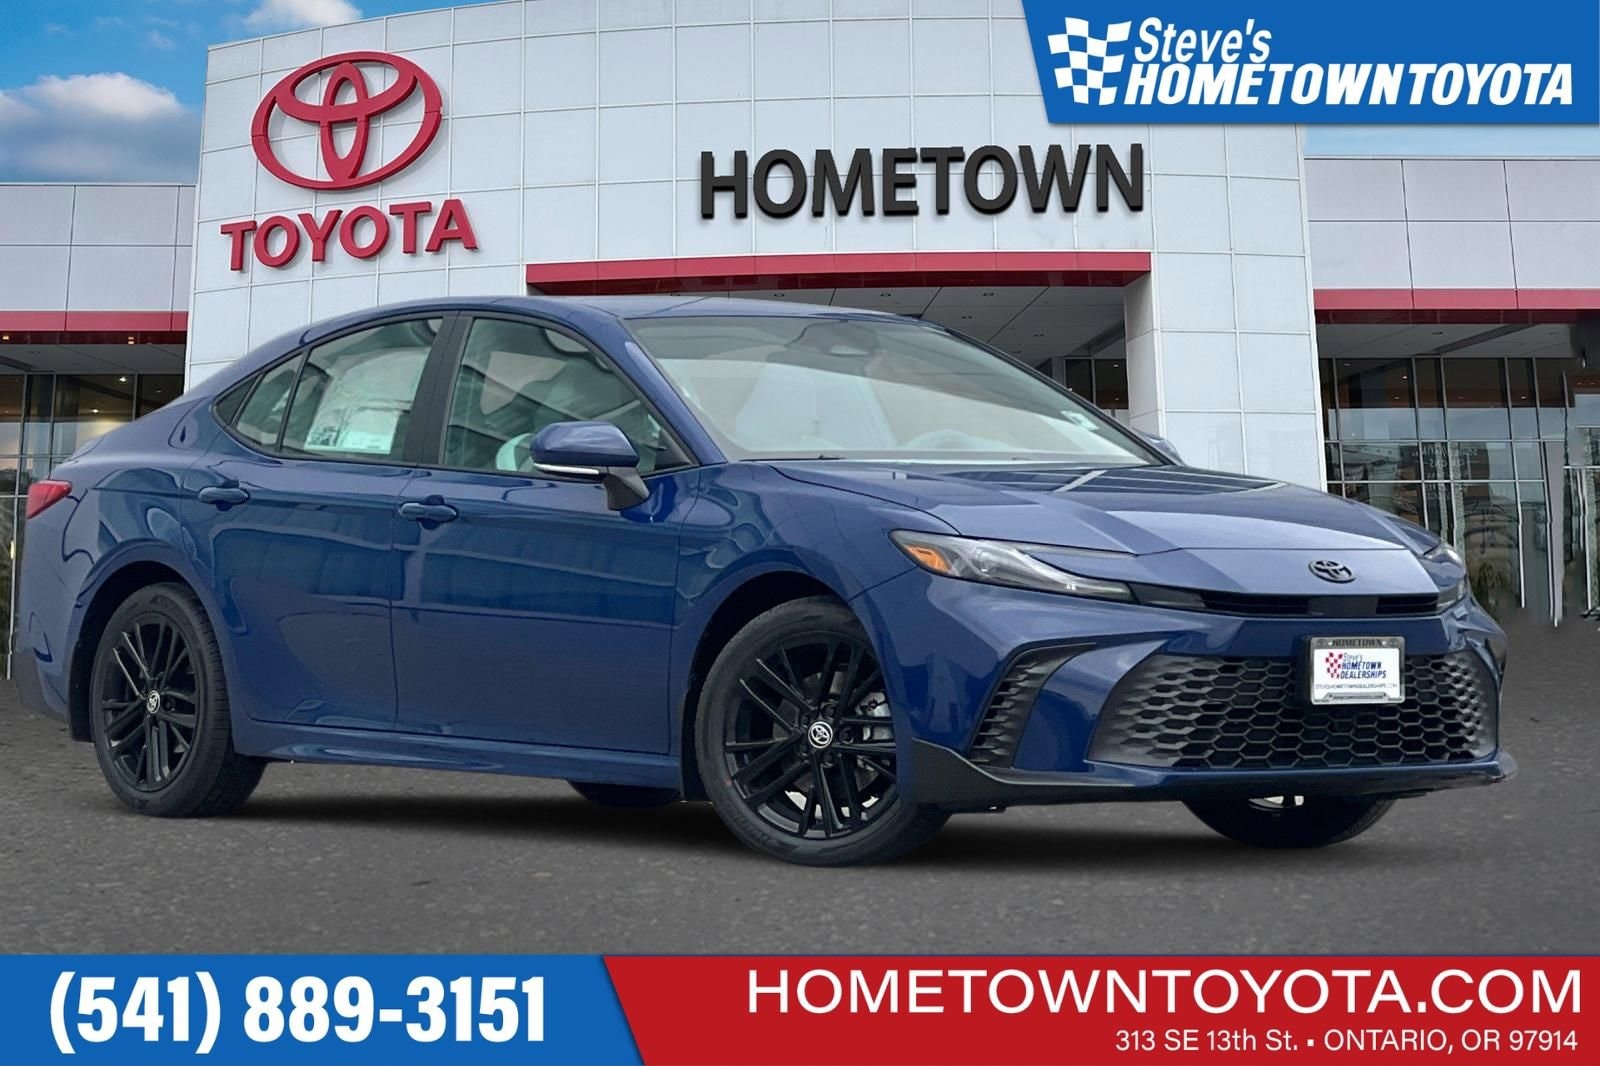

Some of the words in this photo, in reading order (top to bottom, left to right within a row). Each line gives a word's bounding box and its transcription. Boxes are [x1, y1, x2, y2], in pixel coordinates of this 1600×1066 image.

[700, 143, 1144, 219] HOMETOWN
[220, 198, 479, 272] TOYOTA
[1332, 639, 1382, 647] HOMETOWN
[1343, 652, 1363, 662] Steve's
[1341, 661, 1382, 670] HOMETOWN
[1340, 670, 1387, 679] DEALERSHIPS
